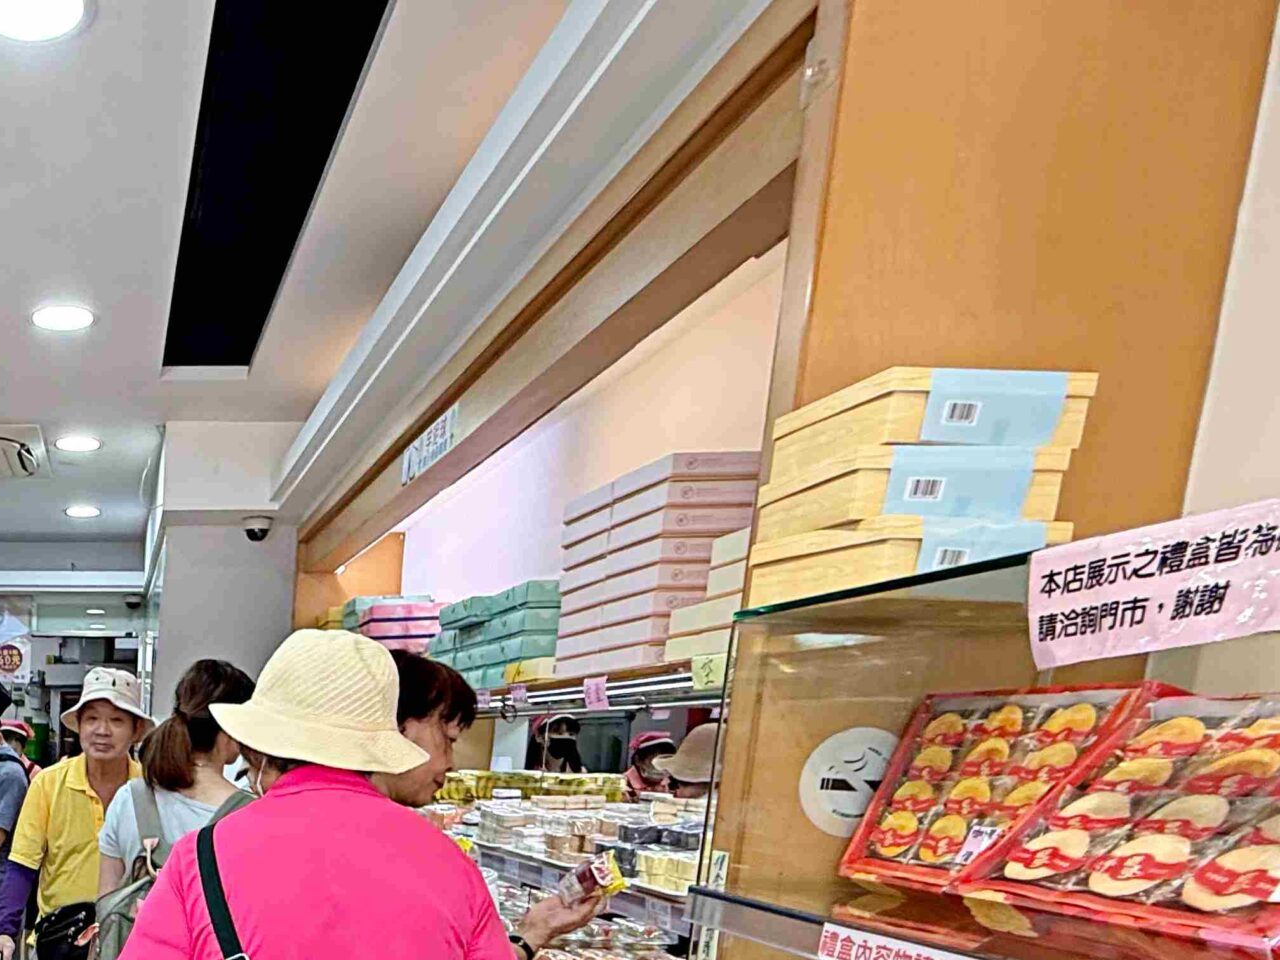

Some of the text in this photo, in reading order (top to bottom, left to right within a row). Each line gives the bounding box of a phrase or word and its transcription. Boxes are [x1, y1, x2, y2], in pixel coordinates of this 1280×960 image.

[1039, 523, 1280, 599] 本店展示之禮盒皆為
